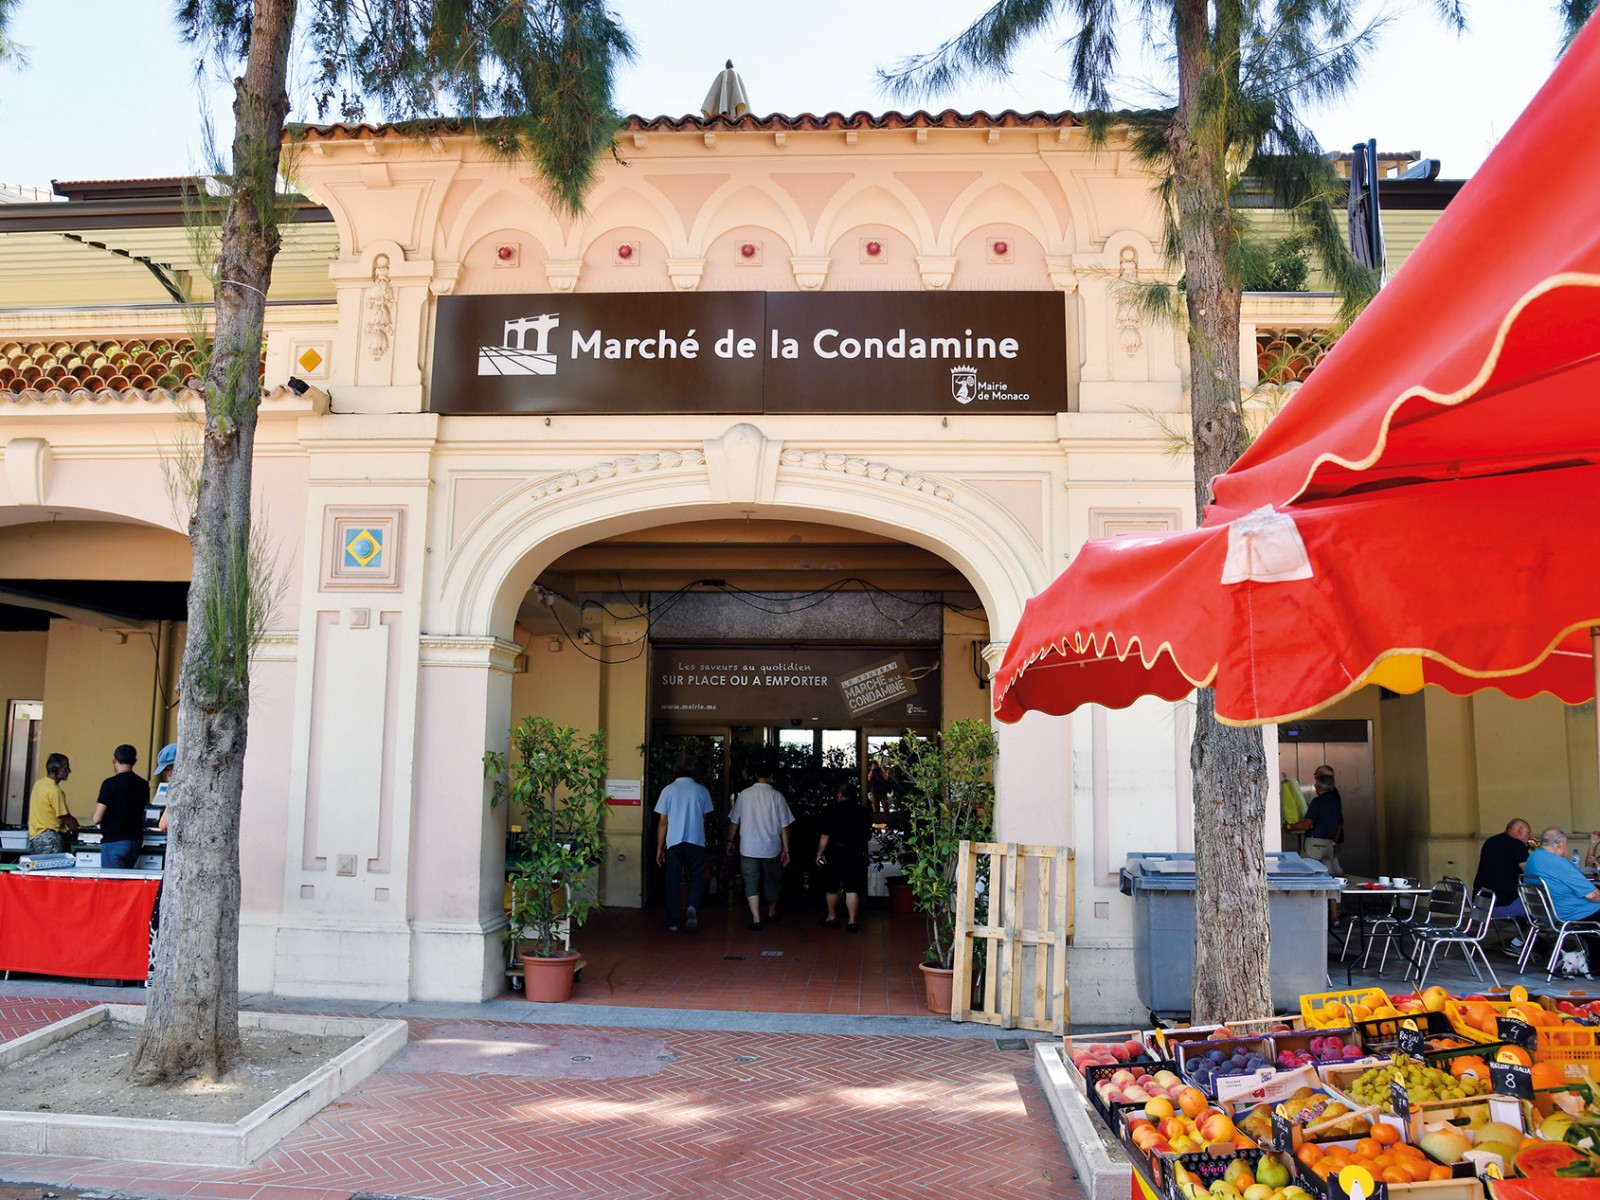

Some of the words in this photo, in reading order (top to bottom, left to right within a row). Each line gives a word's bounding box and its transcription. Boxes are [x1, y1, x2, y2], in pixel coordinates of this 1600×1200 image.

[570, 328, 700, 360] Marché
[714, 328, 757, 360] de
[771, 328, 799, 359] la
[813, 328, 1020, 360] Condamine
[977, 380, 1008, 391] Mairie
[977, 390, 990, 401] de
[991, 390, 1030, 401] Monaco
[678, 662, 695, 671] Les
[699, 664, 738, 672] saveurs
[760, 662, 812, 674] quotidien
[661, 674, 684, 686] SUR
[688, 675, 726, 686] PLACE
[729, 675, 749, 686] OU
[752, 675, 762, 686] A
[765, 675, 829, 687] EMPORTER
[848, 679, 906, 710] CONDAMINE
[660, 703, 717, 711] www.mairie.mc
[1505, 1073, 1516, 1089] 8
